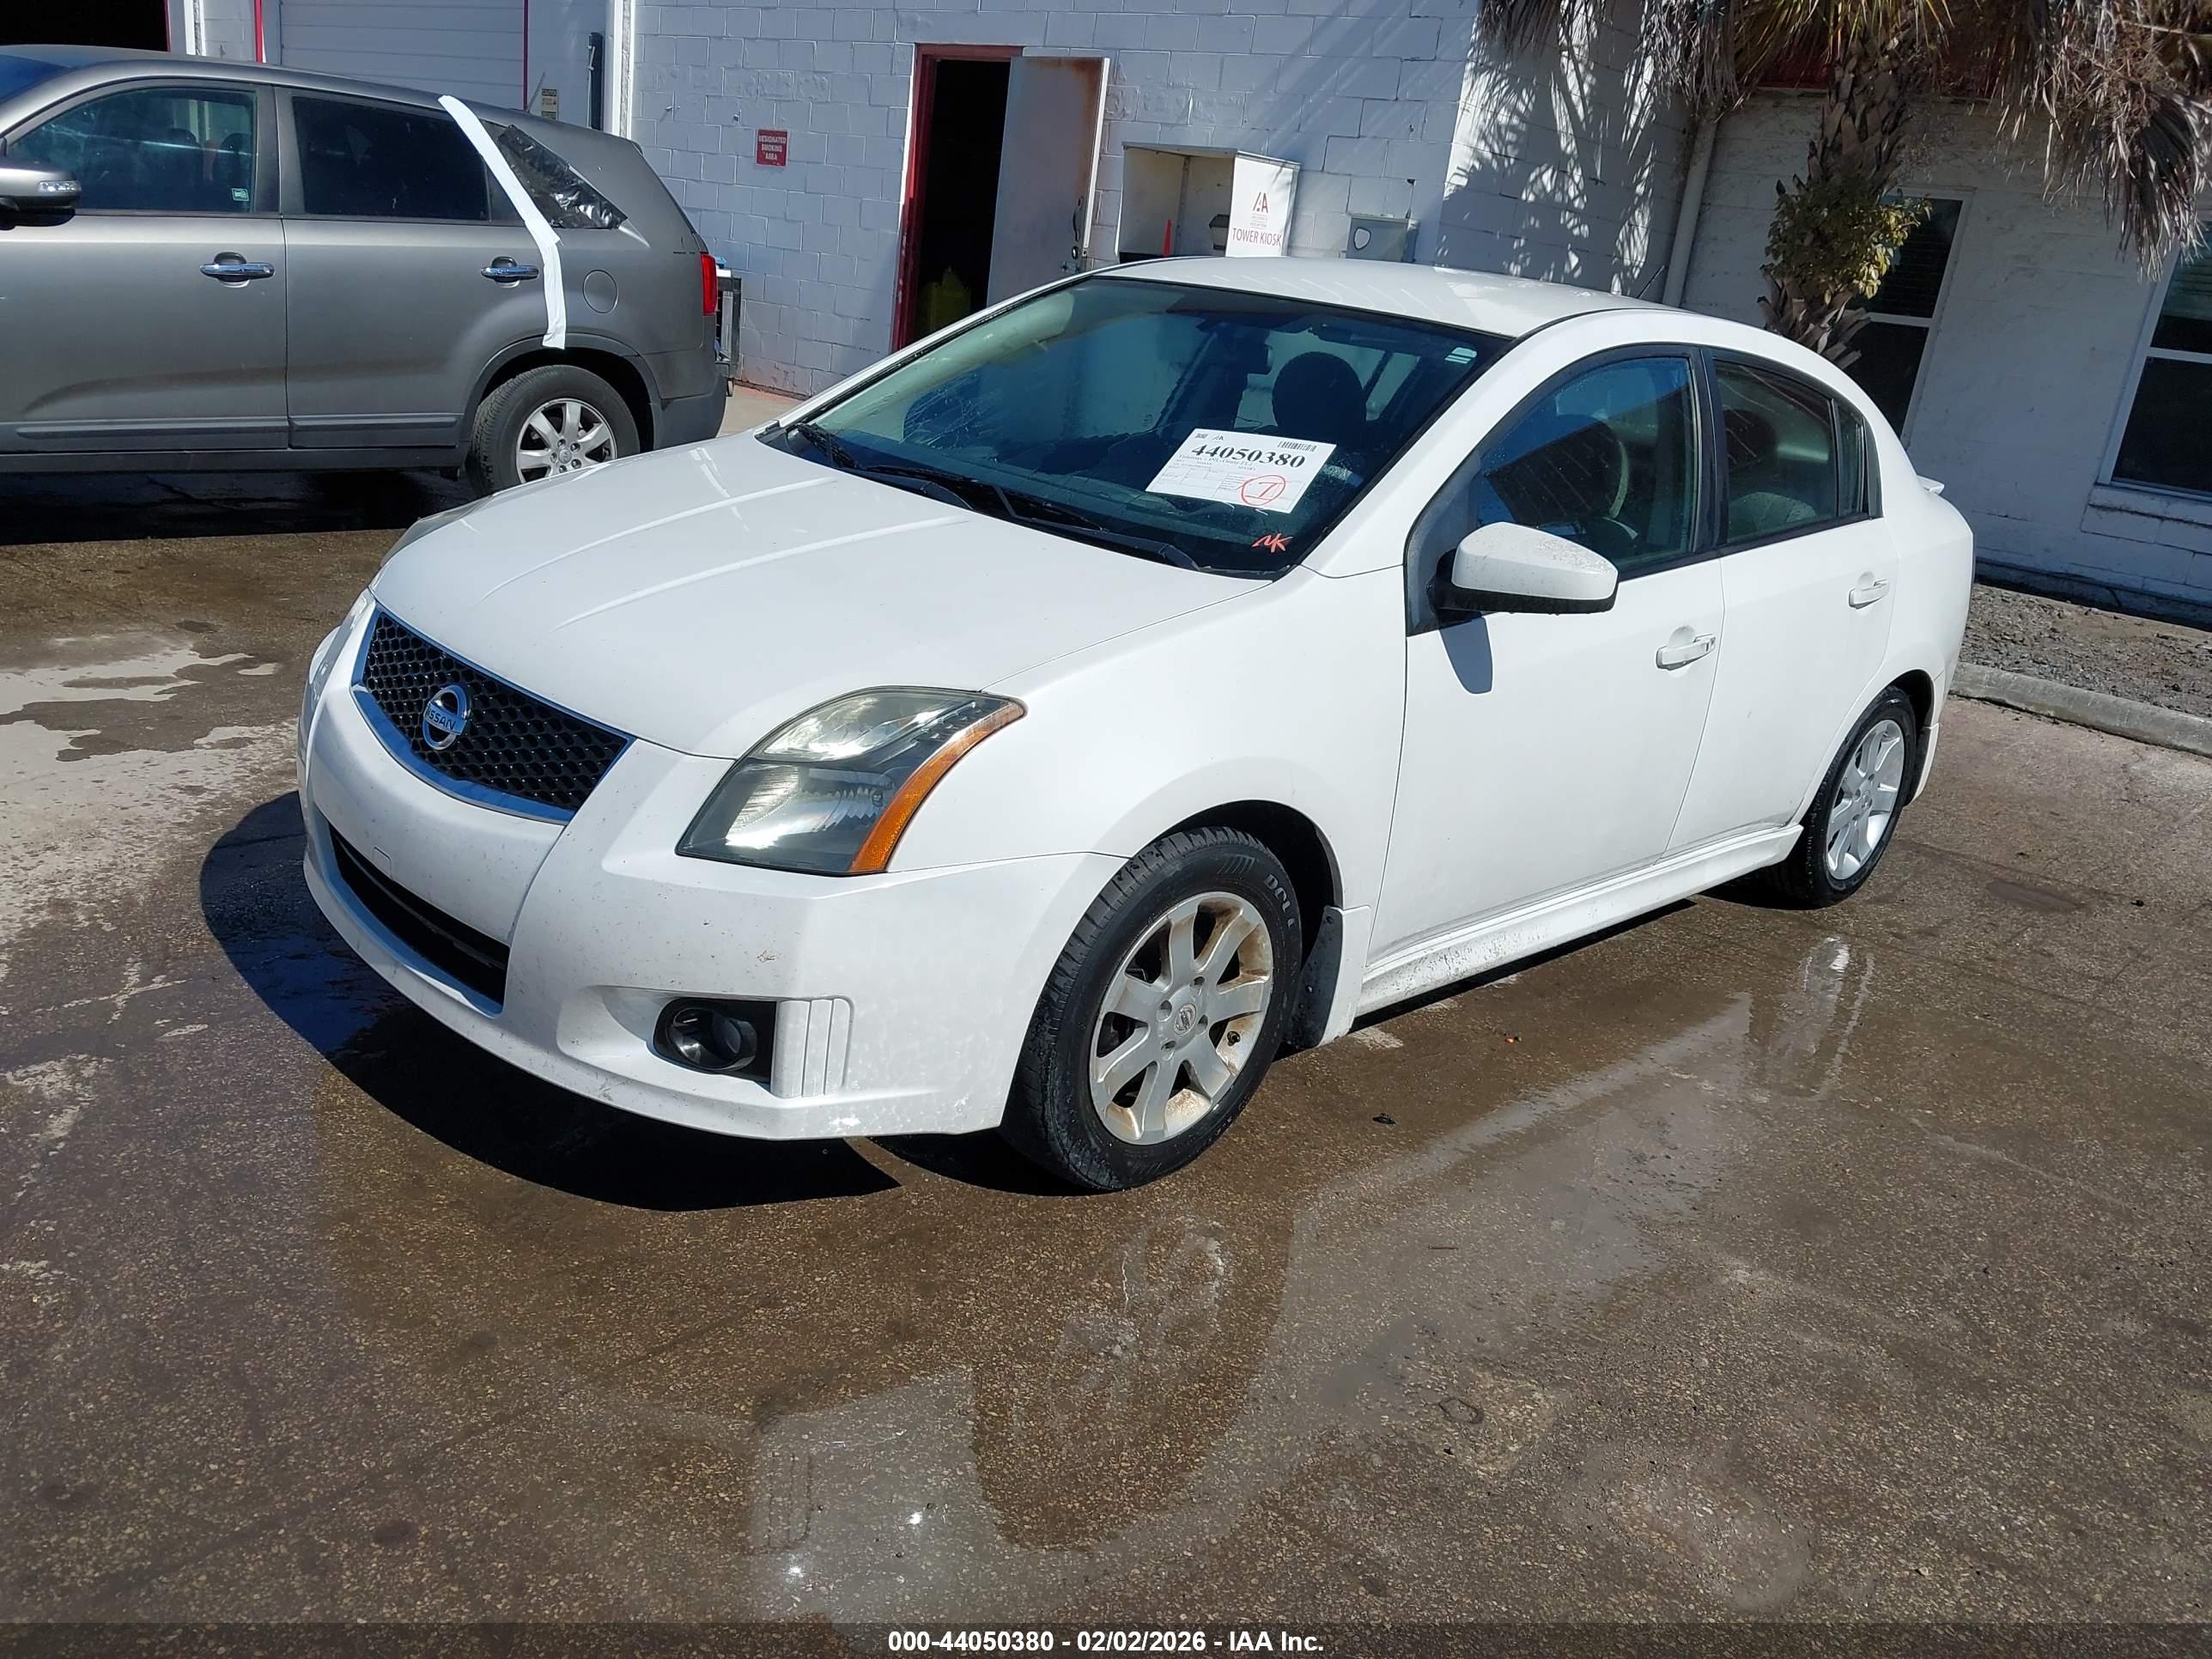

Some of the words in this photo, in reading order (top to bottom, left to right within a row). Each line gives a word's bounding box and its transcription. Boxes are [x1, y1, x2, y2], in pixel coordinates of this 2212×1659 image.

[761, 143, 783, 152] SMOKING
[1232, 228, 1259, 243] TOWER
[1259, 232, 1283, 247] KIOSK
[1191, 444, 1306, 468] 44050380
